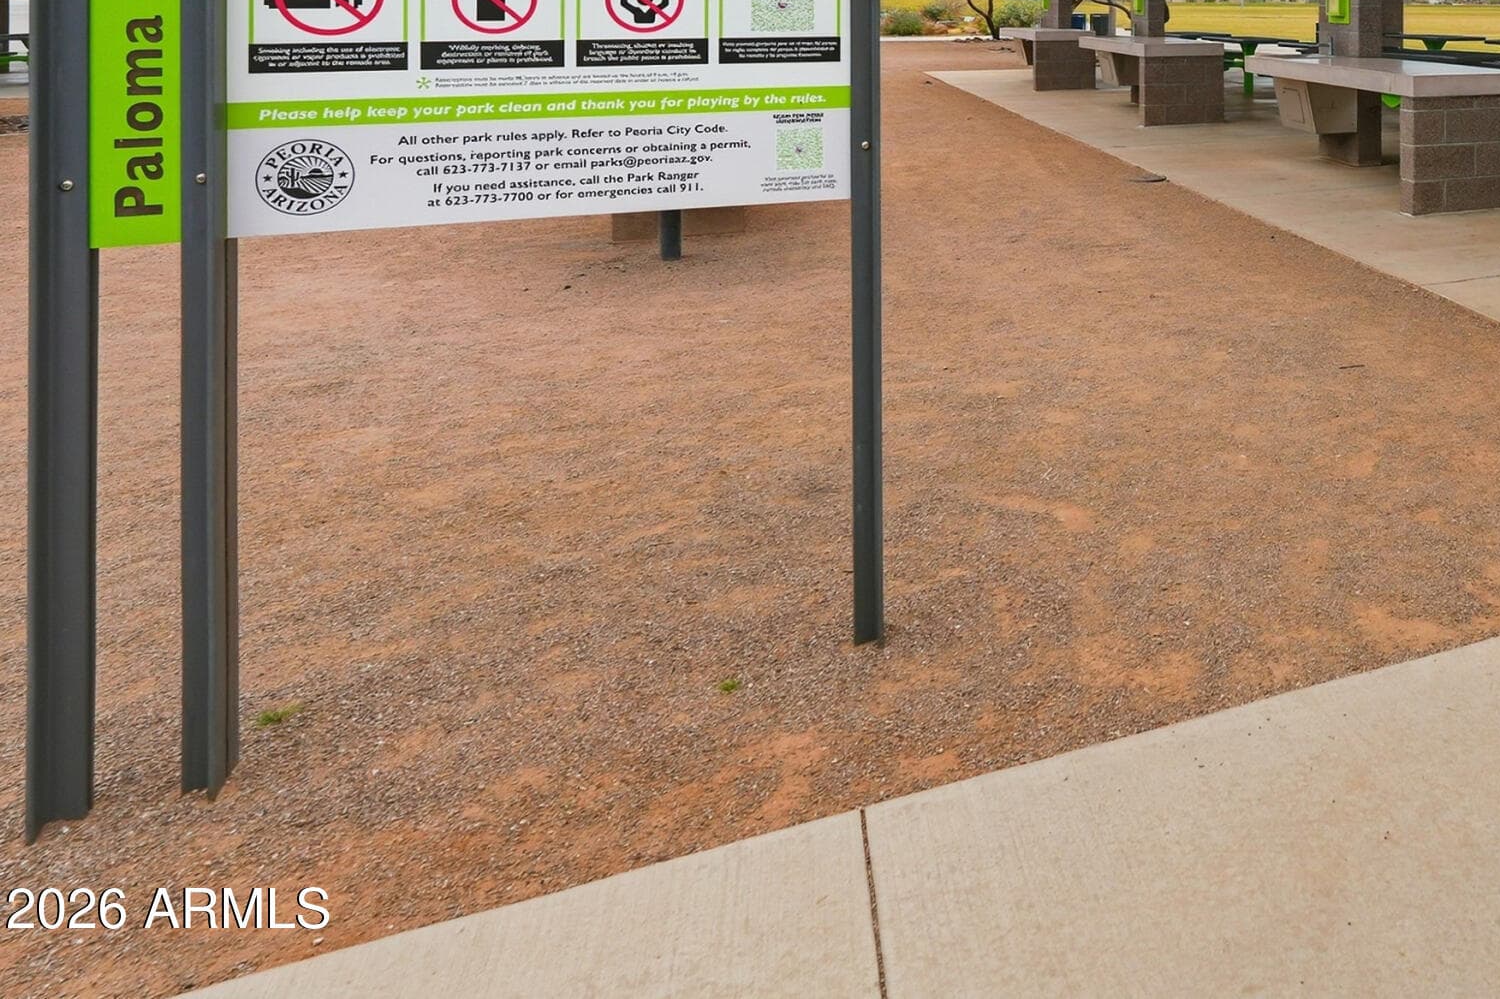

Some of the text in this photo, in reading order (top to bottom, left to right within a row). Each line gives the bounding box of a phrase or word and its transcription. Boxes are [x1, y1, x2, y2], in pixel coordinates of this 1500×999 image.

[113, 14, 163, 218] Paloma
[258, 92, 826, 121] Please help keep your park clean and thank you for playing by the rules.
[397, 123, 728, 146] All other park rules apply. Refer to Peoria City Code.
[265, 142, 344, 169] PEORIA
[369, 154, 394, 165] For
[397, 151, 466, 166] questions,
[469, 148, 531, 162] reporting
[534, 146, 563, 159] park
[566, 146, 622, 156] concerns
[624, 145, 639, 154] or
[641, 141, 697, 156] obtaining
[709, 138, 751, 152] permit,
[415, 154, 713, 176] call 623-773-7137 or email parks@peoriaaz.gov.
[426, 182, 704, 207] at 623-773-7700 or for emergencies call 911.
[432, 170, 700, 195] If you need assistance, call the Park Ranger
[262, 185, 348, 212] ARIZONA
